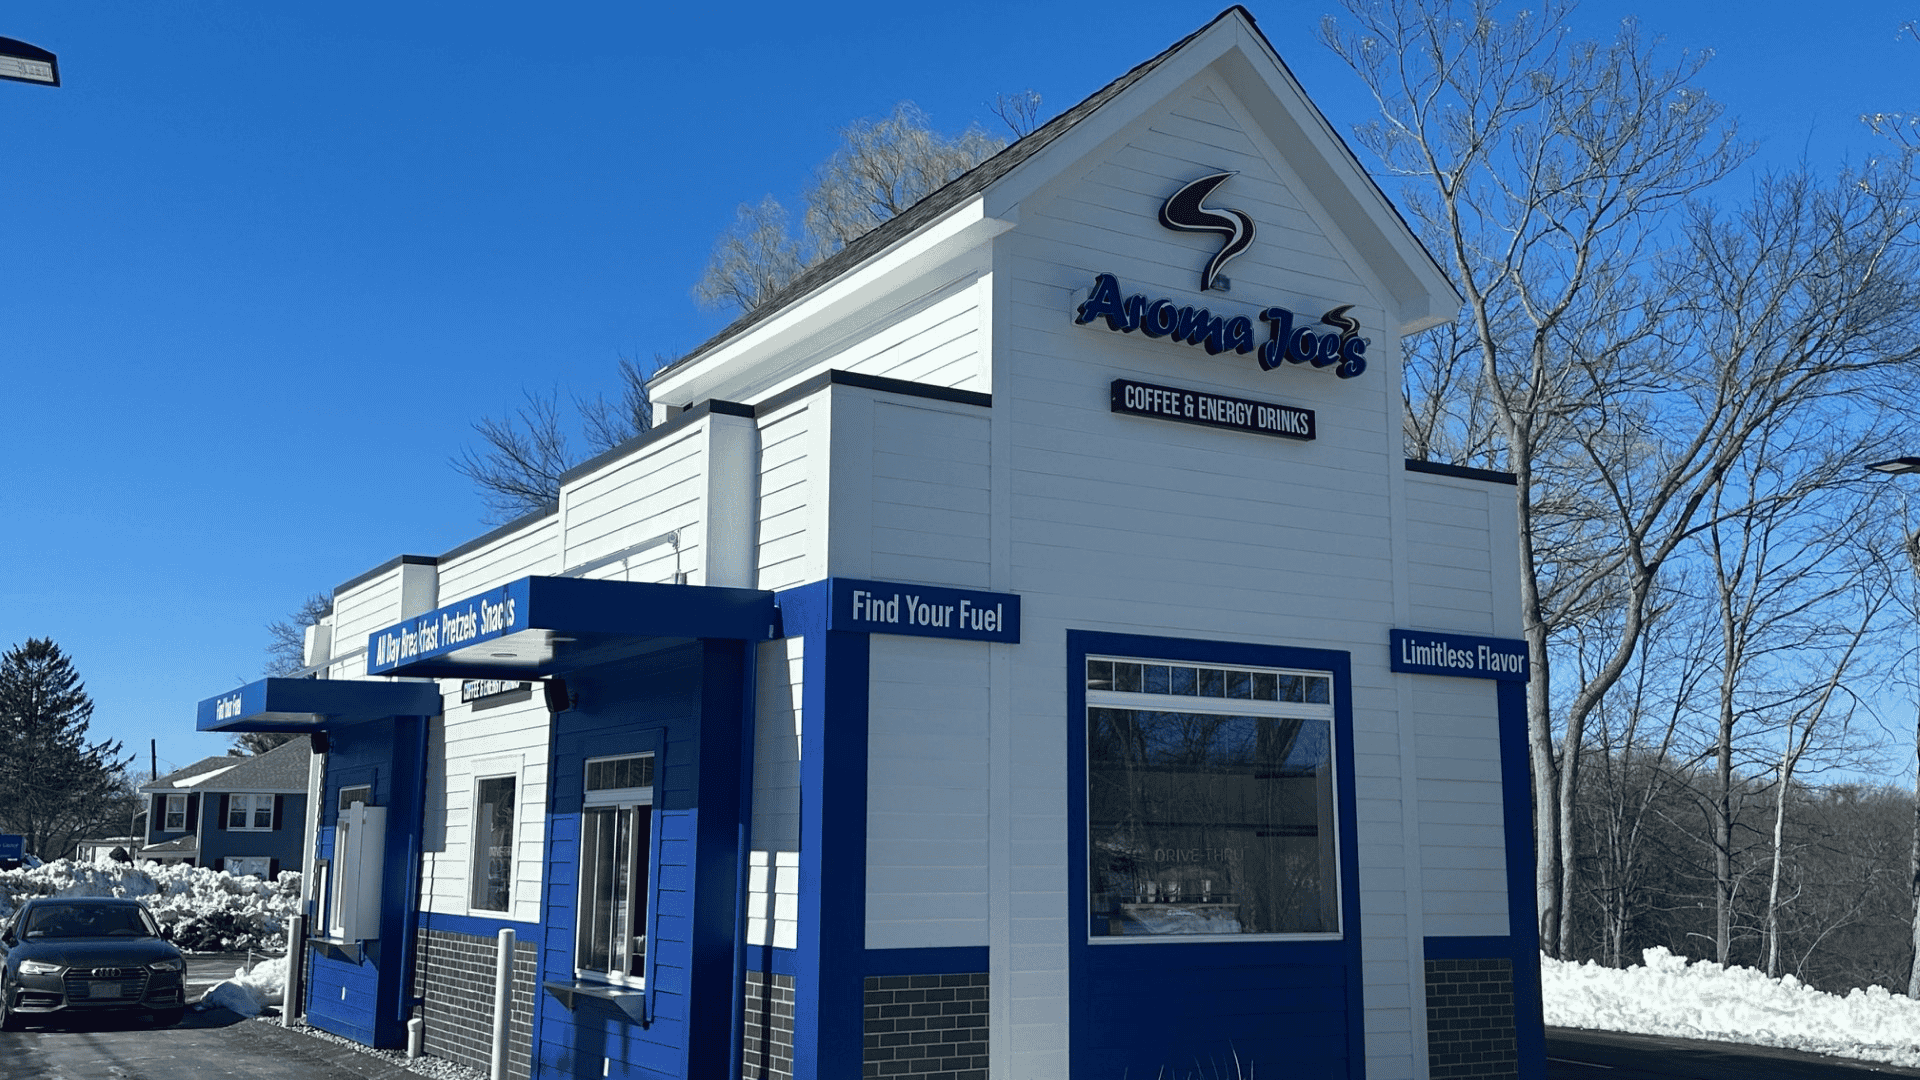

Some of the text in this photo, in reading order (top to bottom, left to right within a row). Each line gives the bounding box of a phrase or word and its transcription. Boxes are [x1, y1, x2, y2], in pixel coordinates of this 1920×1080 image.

[1075, 272, 1255, 355] Aroma
[1125, 384, 1309, 434] COFFEE & ENERGY DRINKS
[376, 592, 516, 668] All Day Breakfast Pretzels Snacks
[852, 590, 1003, 632] Find Your Fuel
[1402, 638, 1525, 673] Limitless Flavor
